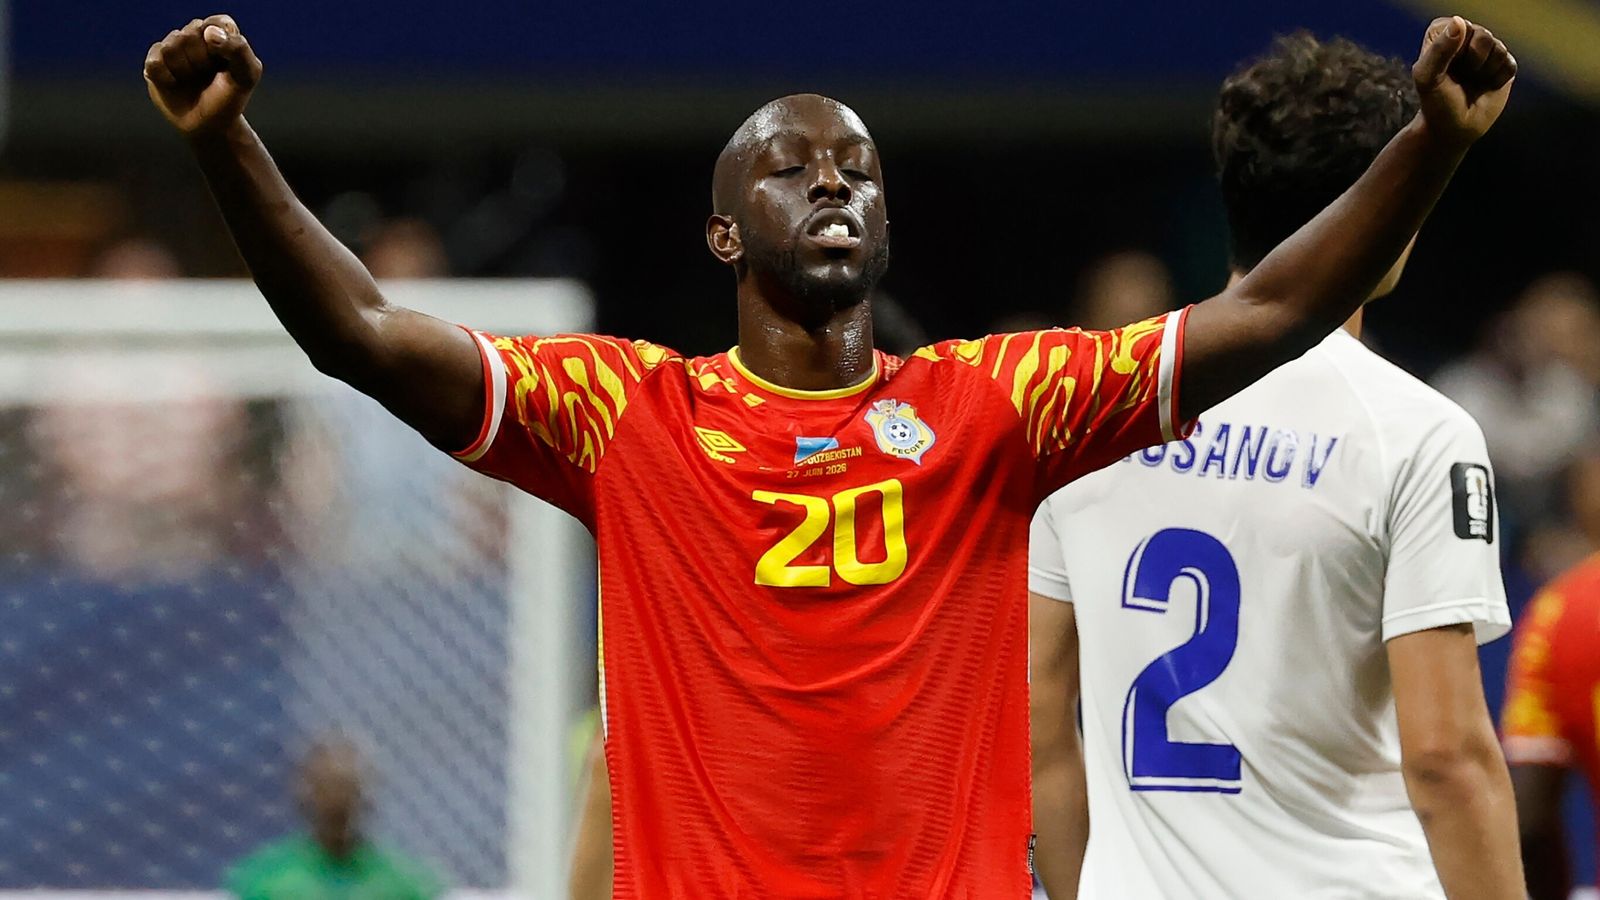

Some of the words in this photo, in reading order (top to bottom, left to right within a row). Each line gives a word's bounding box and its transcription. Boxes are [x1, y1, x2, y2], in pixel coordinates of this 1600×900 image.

[786, 470, 800, 479] 27
[825, 463, 847, 476] 2026
[892, 439, 925, 455] FECOFA
[752, 478, 908, 588] 20
[1121, 527, 1242, 794] 2
